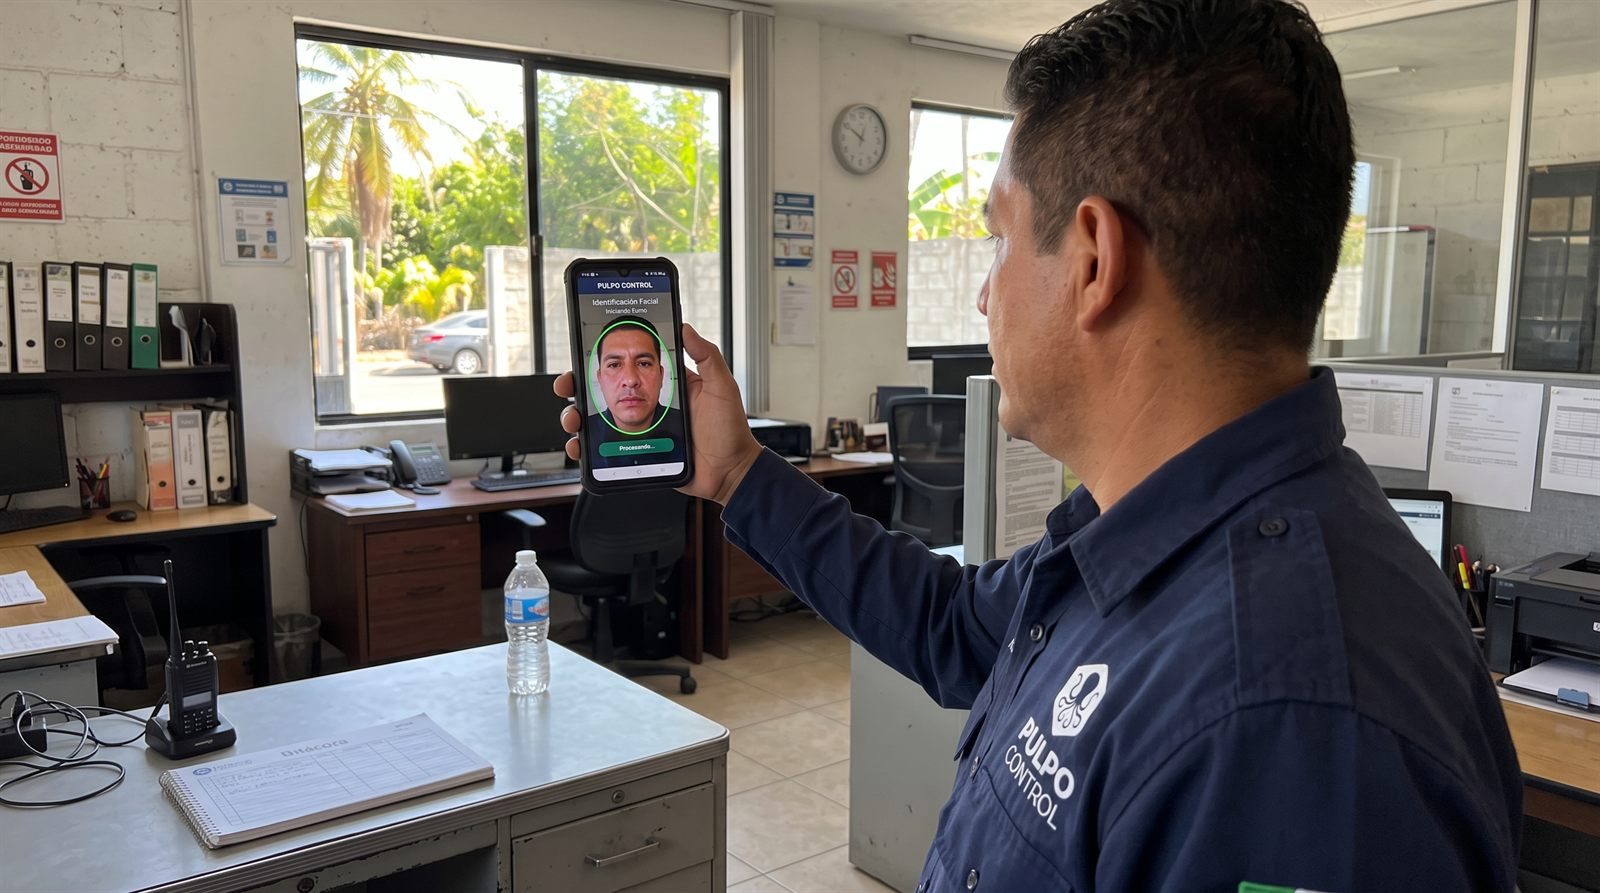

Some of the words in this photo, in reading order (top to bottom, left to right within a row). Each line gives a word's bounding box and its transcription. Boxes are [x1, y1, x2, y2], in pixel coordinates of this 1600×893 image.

[592, 298, 638, 306] Identificación
[639, 297, 659, 305] Facial
[621, 281, 653, 289] CONTROL
[1018, 716, 1076, 800] PULPO
[1005, 745, 1057, 831] CONTROL
